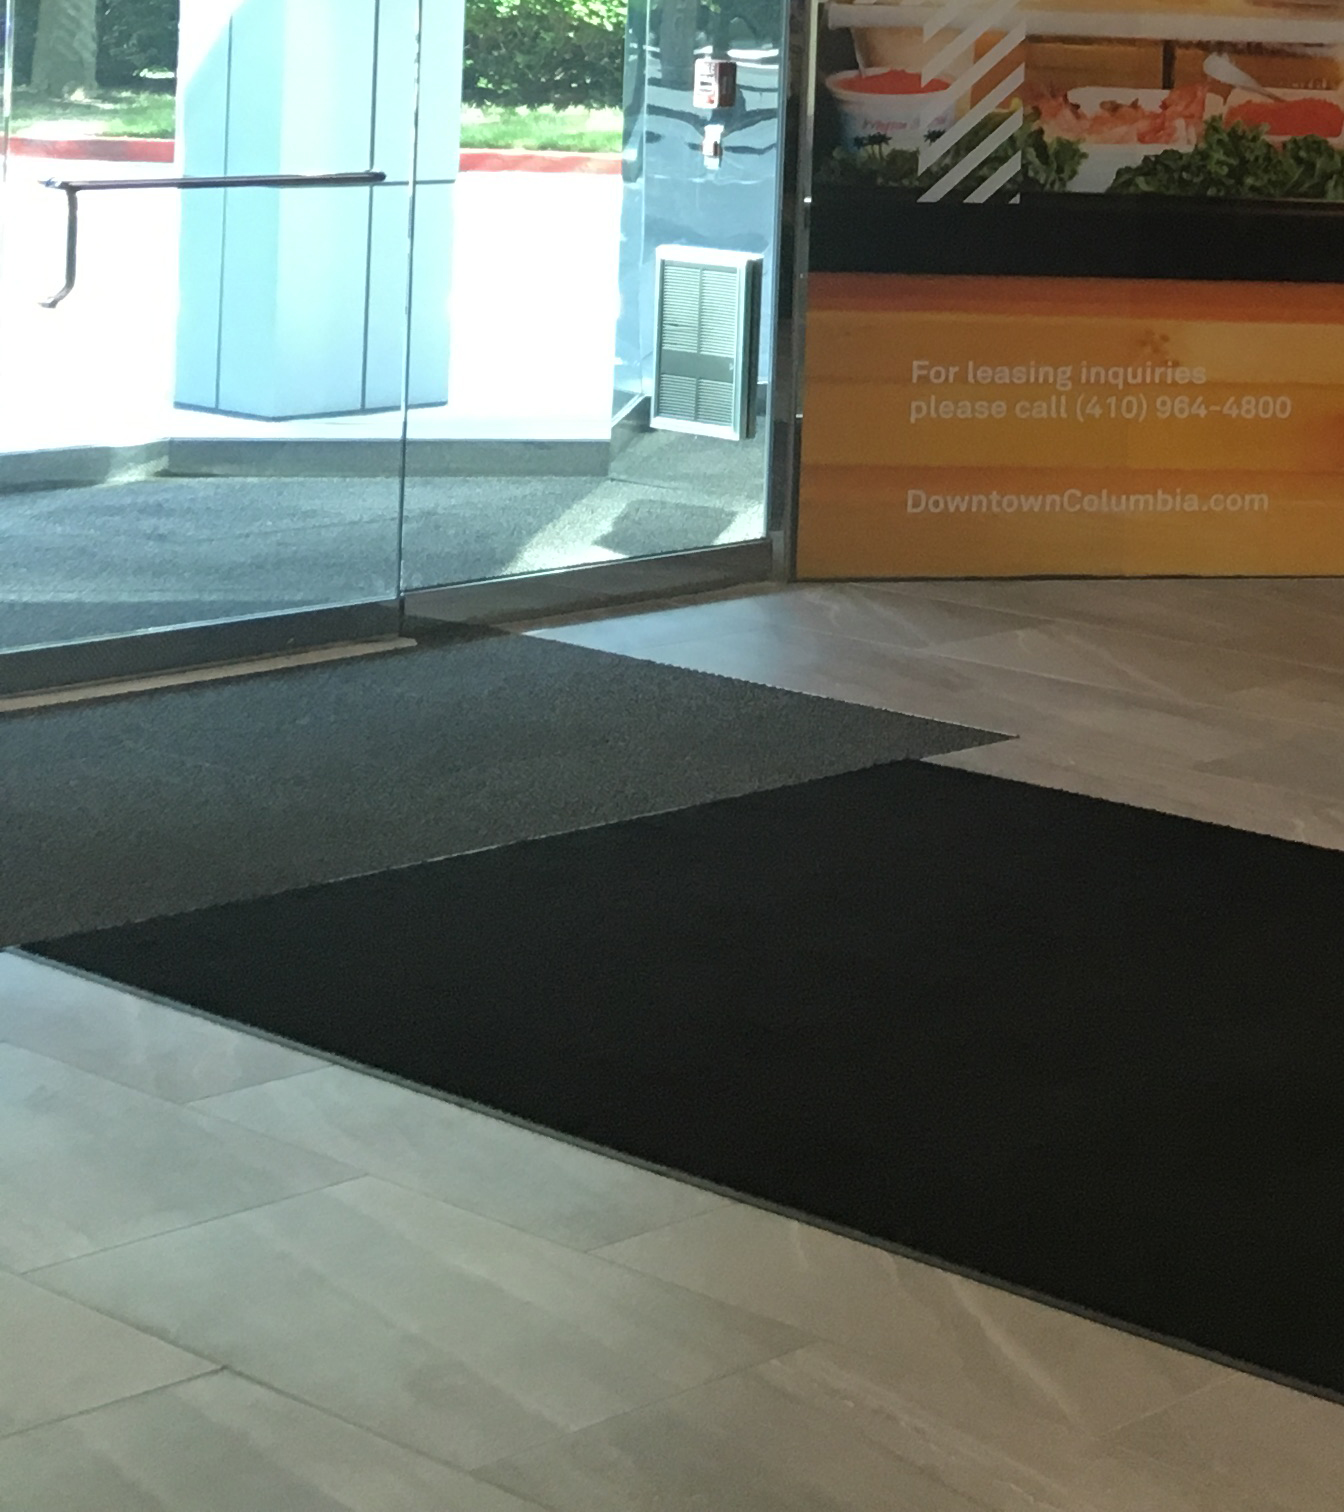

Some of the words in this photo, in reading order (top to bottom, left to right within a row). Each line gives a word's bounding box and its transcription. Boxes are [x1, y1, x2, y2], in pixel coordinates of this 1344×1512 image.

[911, 359, 962, 385] For
[967, 360, 1073, 390] leasing
[1079, 360, 1207, 390] inquiries
[909, 396, 1008, 424] please
[1014, 394, 1067, 419] call
[1076, 394, 1148, 424] (410)
[1154, 395, 1293, 420] 964-4800
[905, 487, 1269, 515] DowntownColumbia.com
